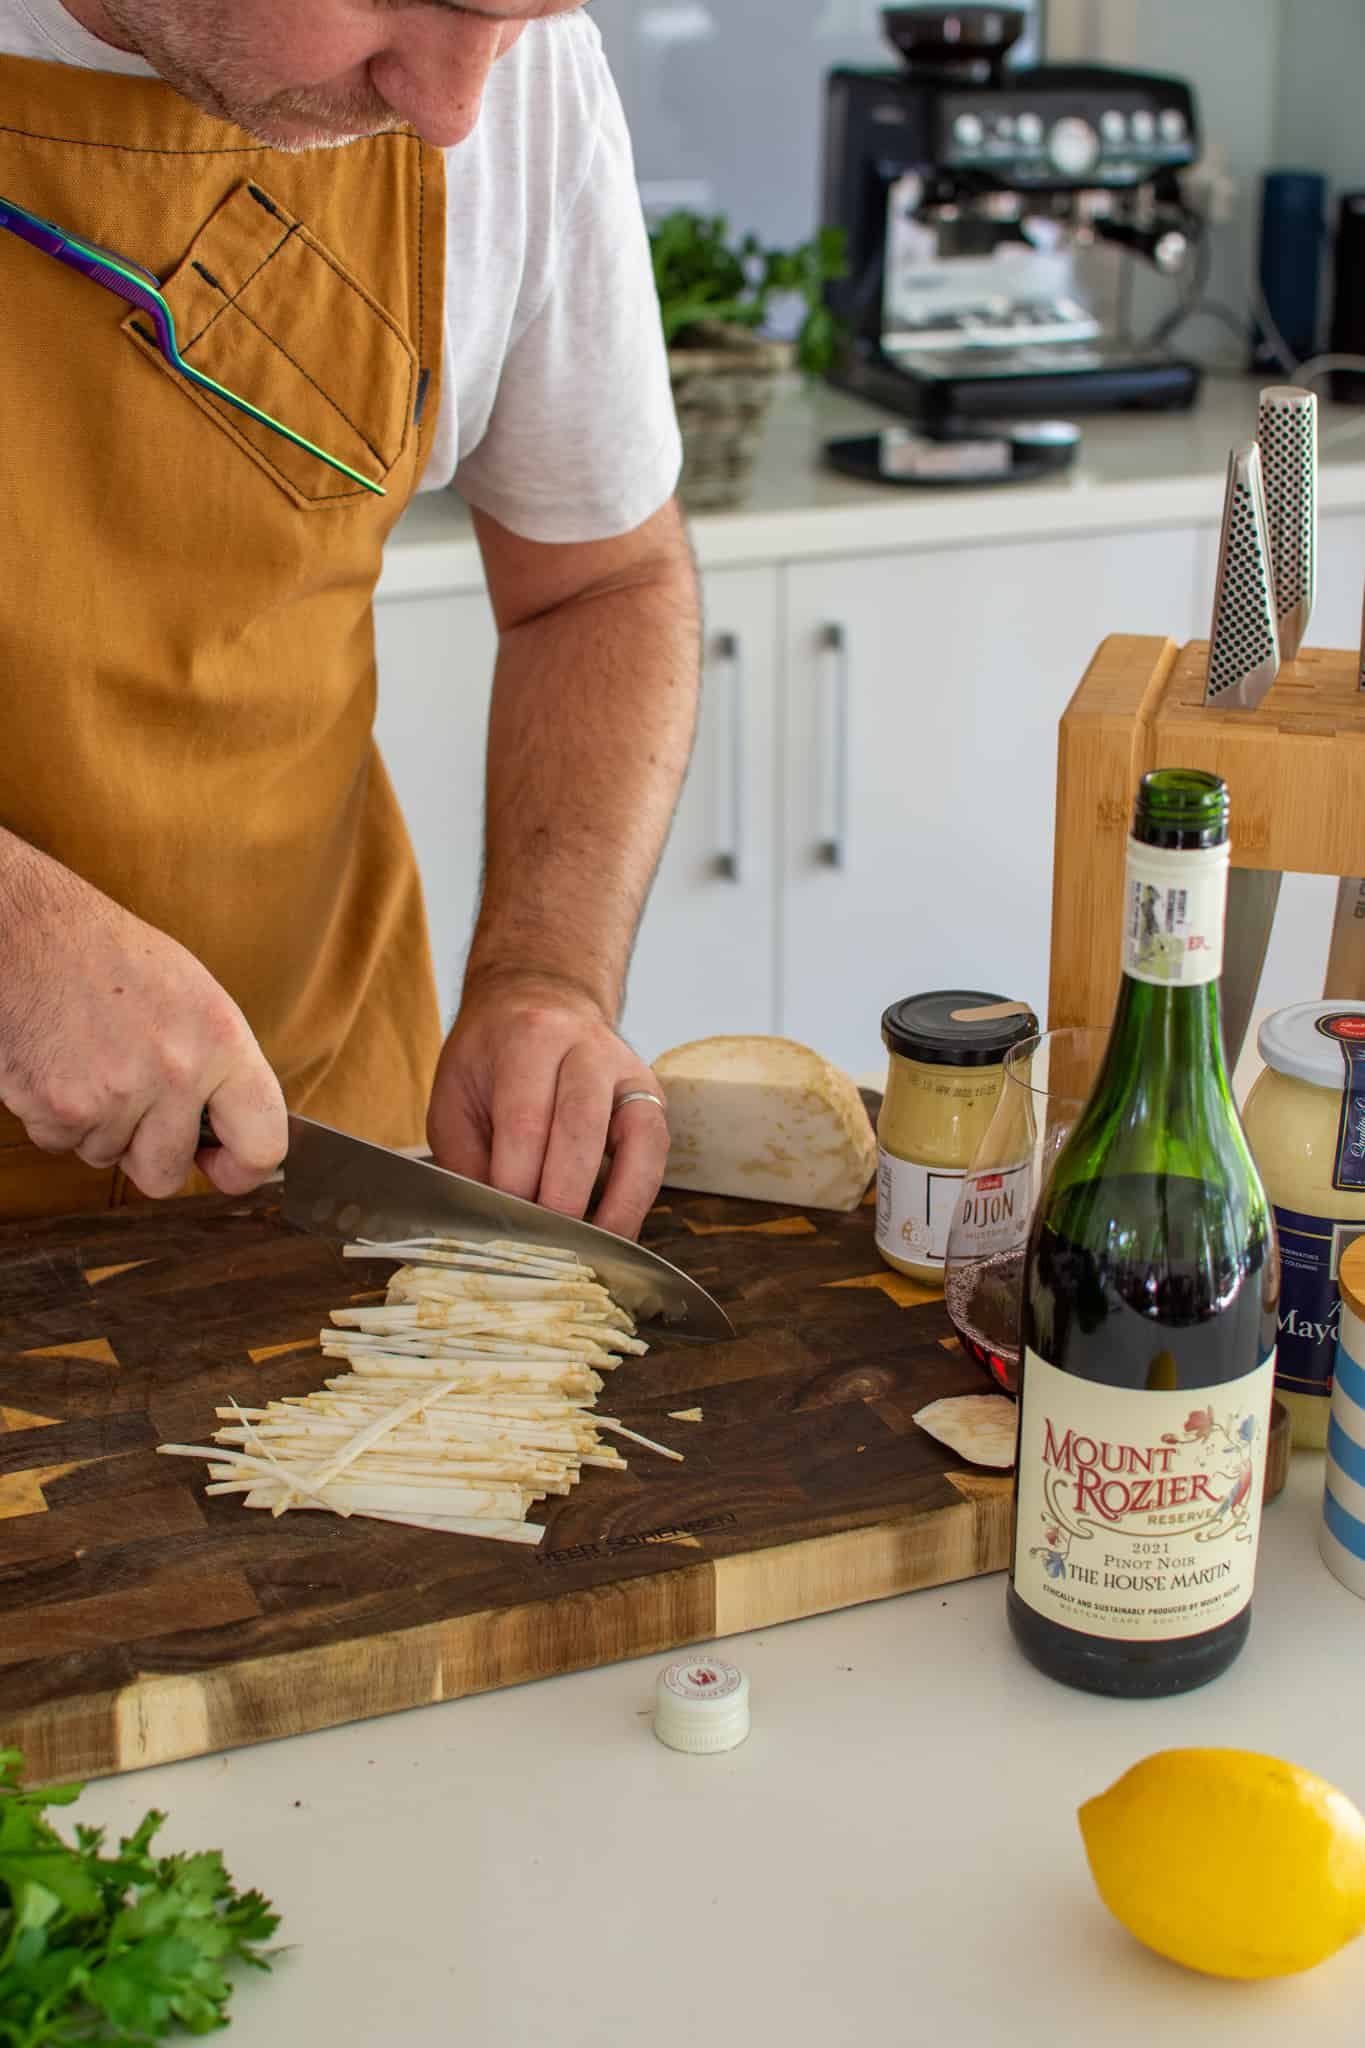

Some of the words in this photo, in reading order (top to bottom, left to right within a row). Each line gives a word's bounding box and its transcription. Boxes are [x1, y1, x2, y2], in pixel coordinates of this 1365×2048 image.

[962, 1188, 1014, 1228] DIJON
[1042, 1417, 1177, 1474] MOUNT
[1073, 1466, 1224, 1522] ROZIER
[1147, 1508, 1214, 1526] RESERVE
[1104, 1554, 1153, 1570] PINOT
[1158, 1556, 1196, 1570] NOIR
[1132, 1543, 1169, 1554] 2021
[1068, 1563, 1099, 1585] THE
[1104, 1572, 1166, 1591] HOUSE
[1170, 1560, 1232, 1590] MARTIN
[1043, 1583, 1075, 1603] ETHICALLY
[1078, 1599, 1092, 1608] AND
[1094, 1603, 1145, 1616] SUSTAINABLY
[1148, 1604, 1187, 1615] PRODUCED
[1189, 1602, 1198, 1610] BY
